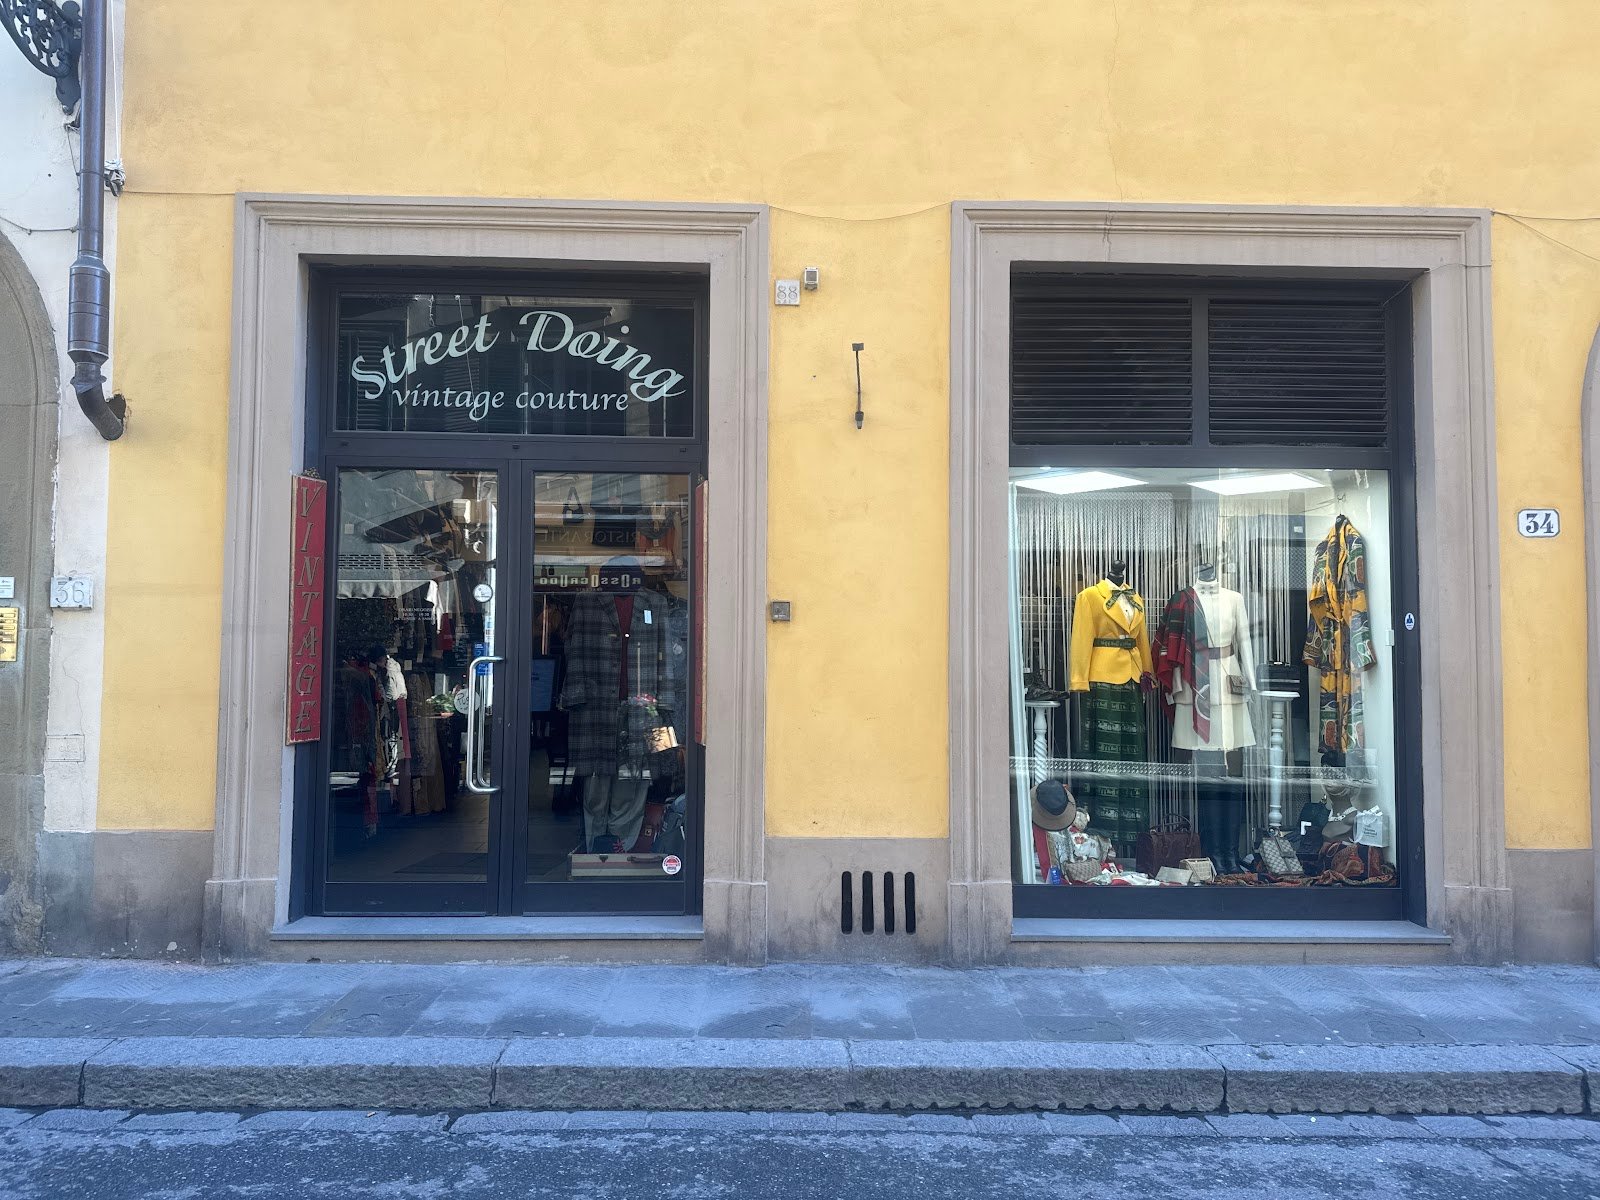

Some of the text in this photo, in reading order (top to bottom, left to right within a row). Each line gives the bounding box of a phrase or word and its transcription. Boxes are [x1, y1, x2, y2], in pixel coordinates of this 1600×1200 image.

[777, 284, 798, 300] 88
[351, 310, 687, 402] Street Doing
[391, 384, 629, 422] vintage couture
[1525, 512, 1555, 534] 34
[55, 581, 85, 604] 36
[295, 485, 322, 733] VINTAGE
